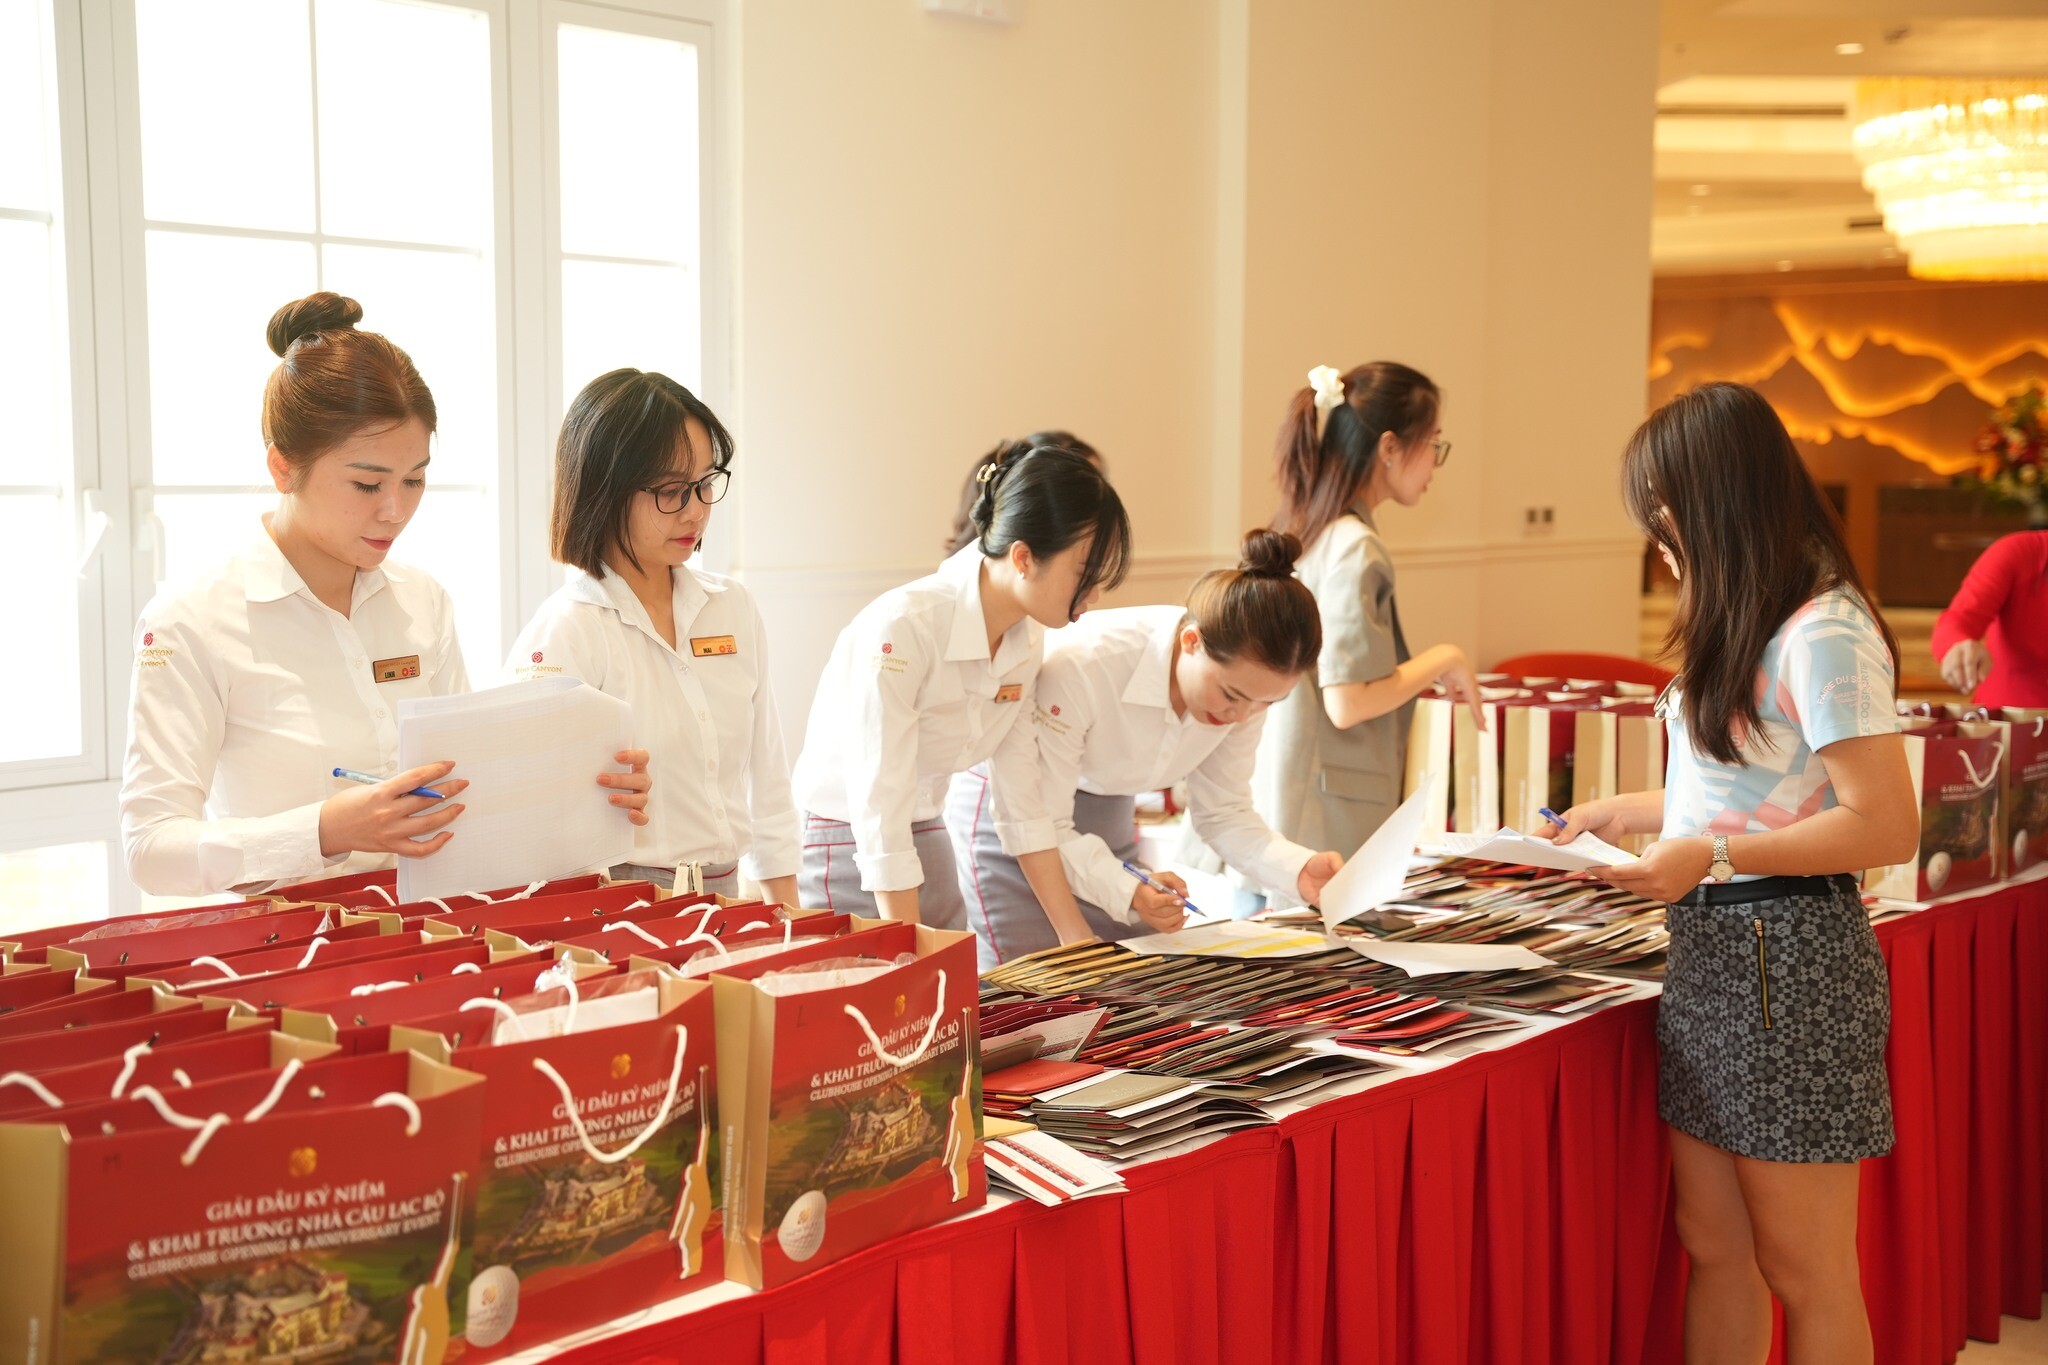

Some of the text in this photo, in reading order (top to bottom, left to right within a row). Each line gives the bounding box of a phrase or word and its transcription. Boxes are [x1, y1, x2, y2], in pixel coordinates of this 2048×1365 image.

[1817, 681, 1836, 705] FAIRE
[1836, 675, 1849, 685] DU
[858, 1042, 878, 1057] GI
[810, 1080, 864, 1102] CLUBHOUSE
[863, 1067, 893, 1089] OPENING
[940, 1036, 959, 1054] EVENT
[810, 1073, 822, 1088] &
[823, 1066, 855, 1086] KHAI
[494, 1136, 508, 1154] &
[510, 1129, 549, 1151] KHAI
[494, 1143, 560, 1170] CLUBHOUSE
[560, 1133, 608, 1155] OPENG
[127, 1239, 146, 1263] &
[149, 1230, 201, 1258] KHAI
[297, 1208, 343, 1234] NHÀ
[127, 1250, 219, 1281] CLUBHOUSE
[219, 1238, 288, 1264] OPENING
